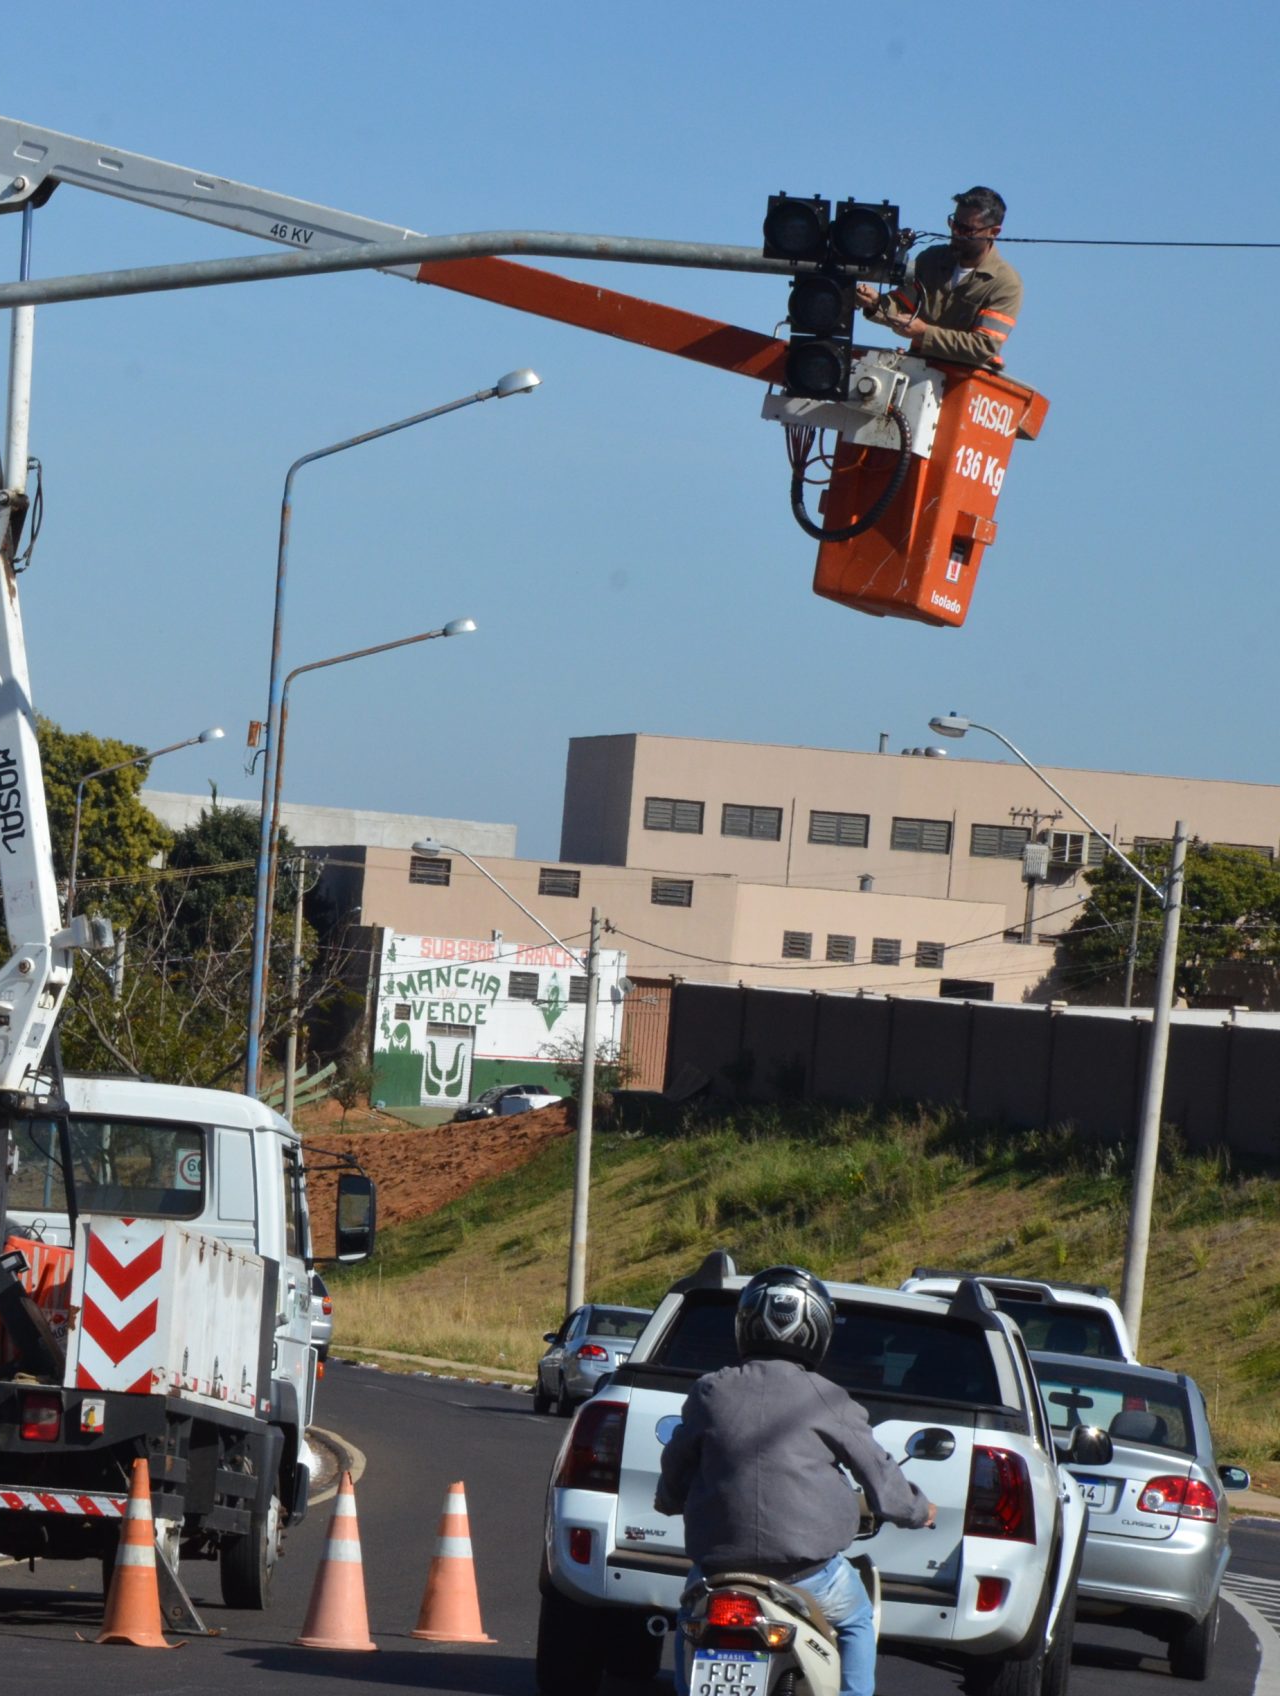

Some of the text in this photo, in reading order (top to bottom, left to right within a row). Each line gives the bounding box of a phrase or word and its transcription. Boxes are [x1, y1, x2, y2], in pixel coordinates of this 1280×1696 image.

[270, 223, 314, 244] 46 KV
[968, 394, 1017, 438] MASAL
[955, 445, 1006, 496] 136 Kg
[931, 590, 961, 614] Isolado
[396, 966, 501, 1008] MANCHA
[411, 1000, 488, 1026] VERDE
[1121, 1519, 1157, 1530] CLASSIC
[717, 1653, 746, 1661] BRASIL
[709, 1662, 752, 1683] FCF
